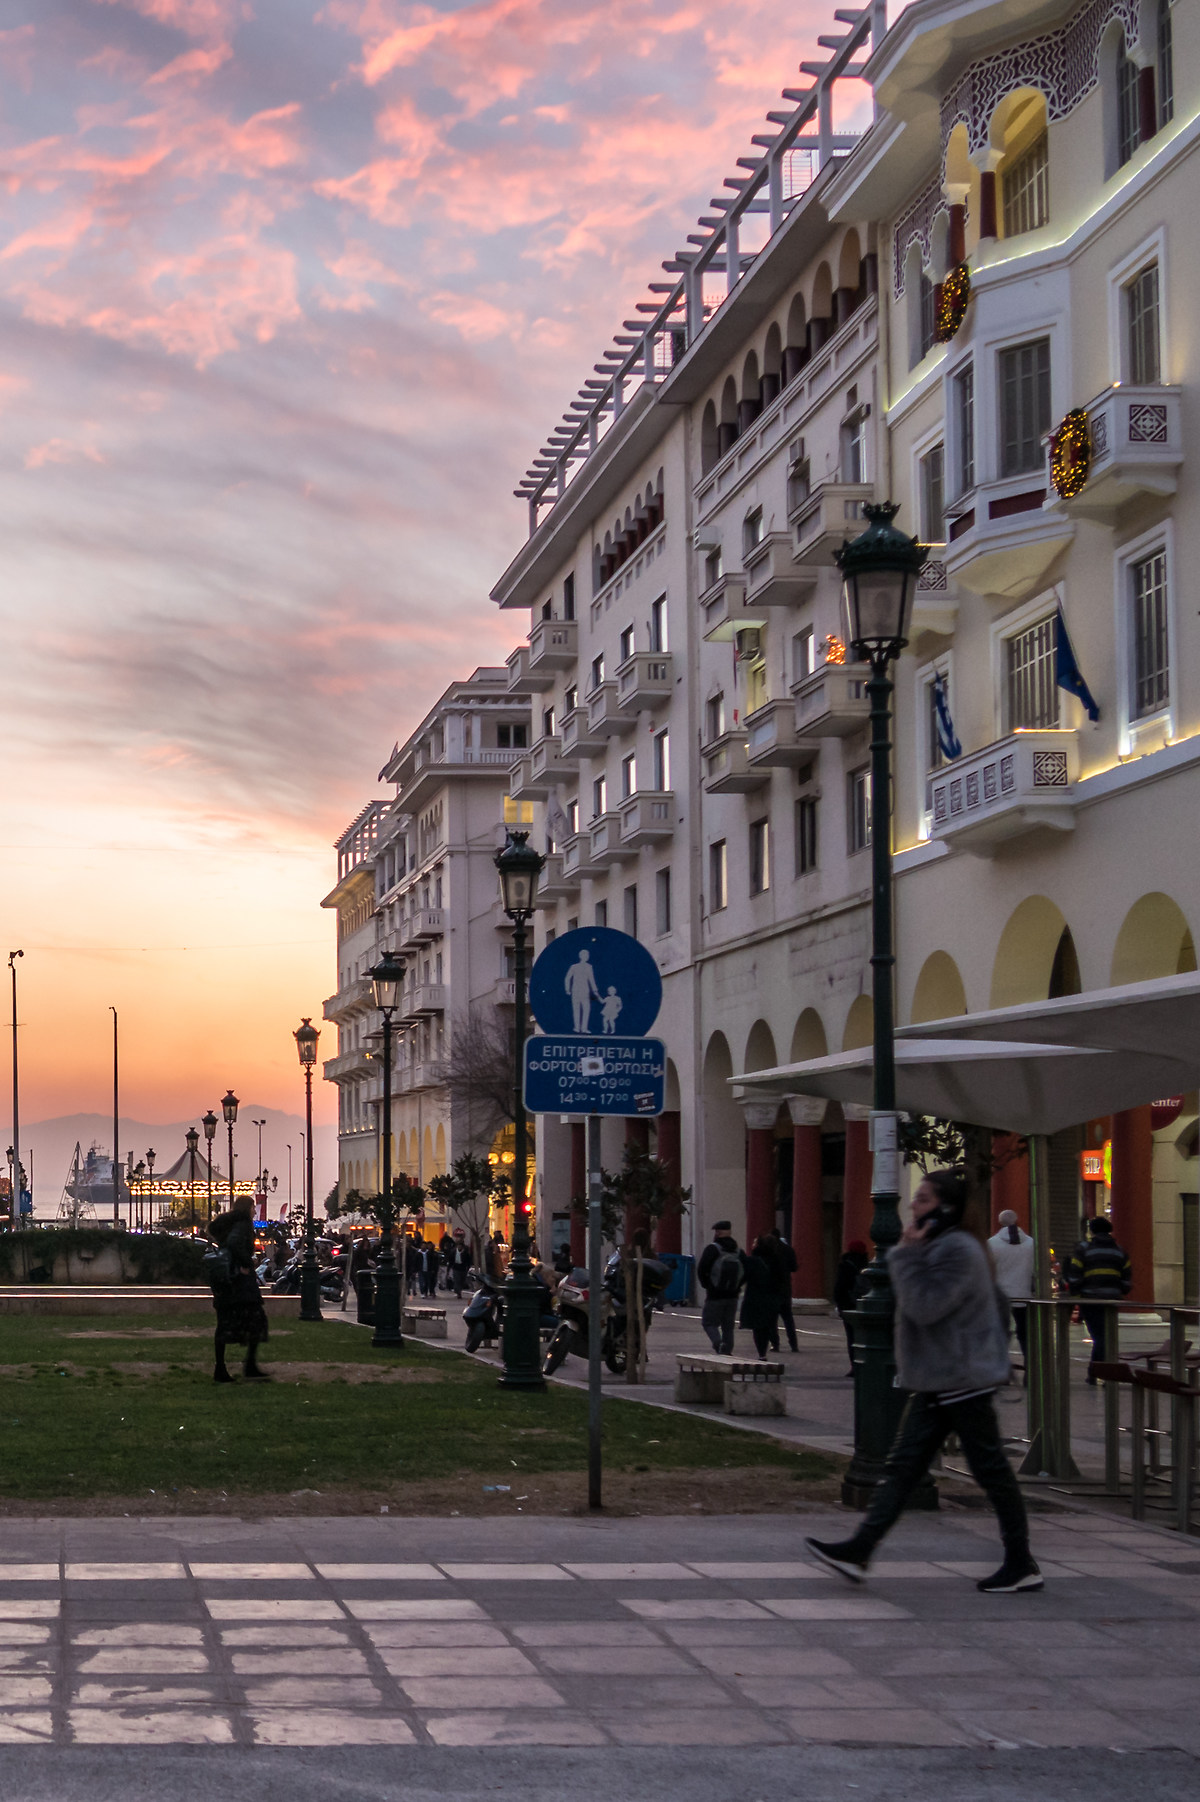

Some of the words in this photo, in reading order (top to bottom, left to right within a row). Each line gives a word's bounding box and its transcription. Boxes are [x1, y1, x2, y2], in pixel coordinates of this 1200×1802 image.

[543, 1045, 636, 1059] ΕΠΙΤΡΕΠΕΤΑΙ
[642, 1048, 653, 1059] Η
[529, 1060, 661, 1075] ΦΟΡΤΟΕΟΡΤΩΣΗ
[1151, 1098, 1181, 1107] enter
